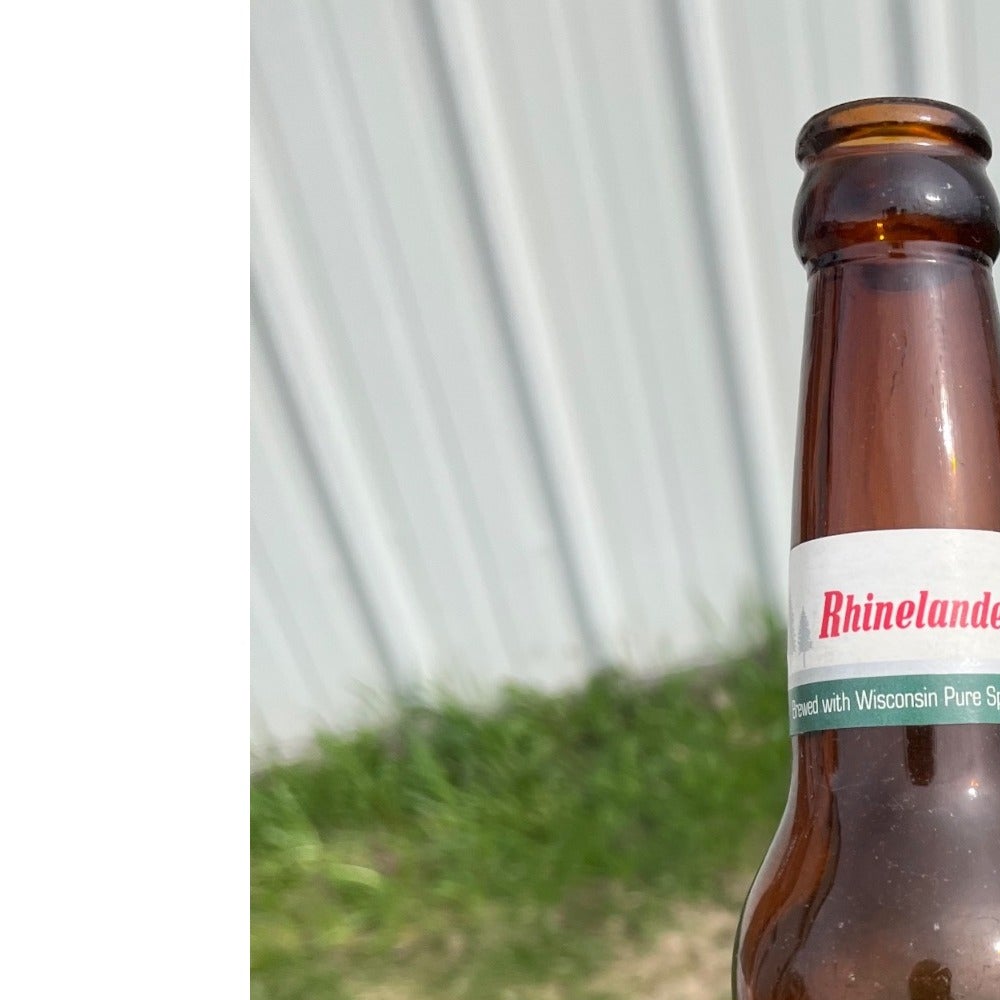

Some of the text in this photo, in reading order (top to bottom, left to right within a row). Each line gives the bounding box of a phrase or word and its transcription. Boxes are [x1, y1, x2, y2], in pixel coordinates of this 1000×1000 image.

[791, 694, 819, 719] Brewed
[822, 692, 850, 713] with
[855, 686, 938, 711] Wisconsin
[944, 686, 981, 707] Pure
